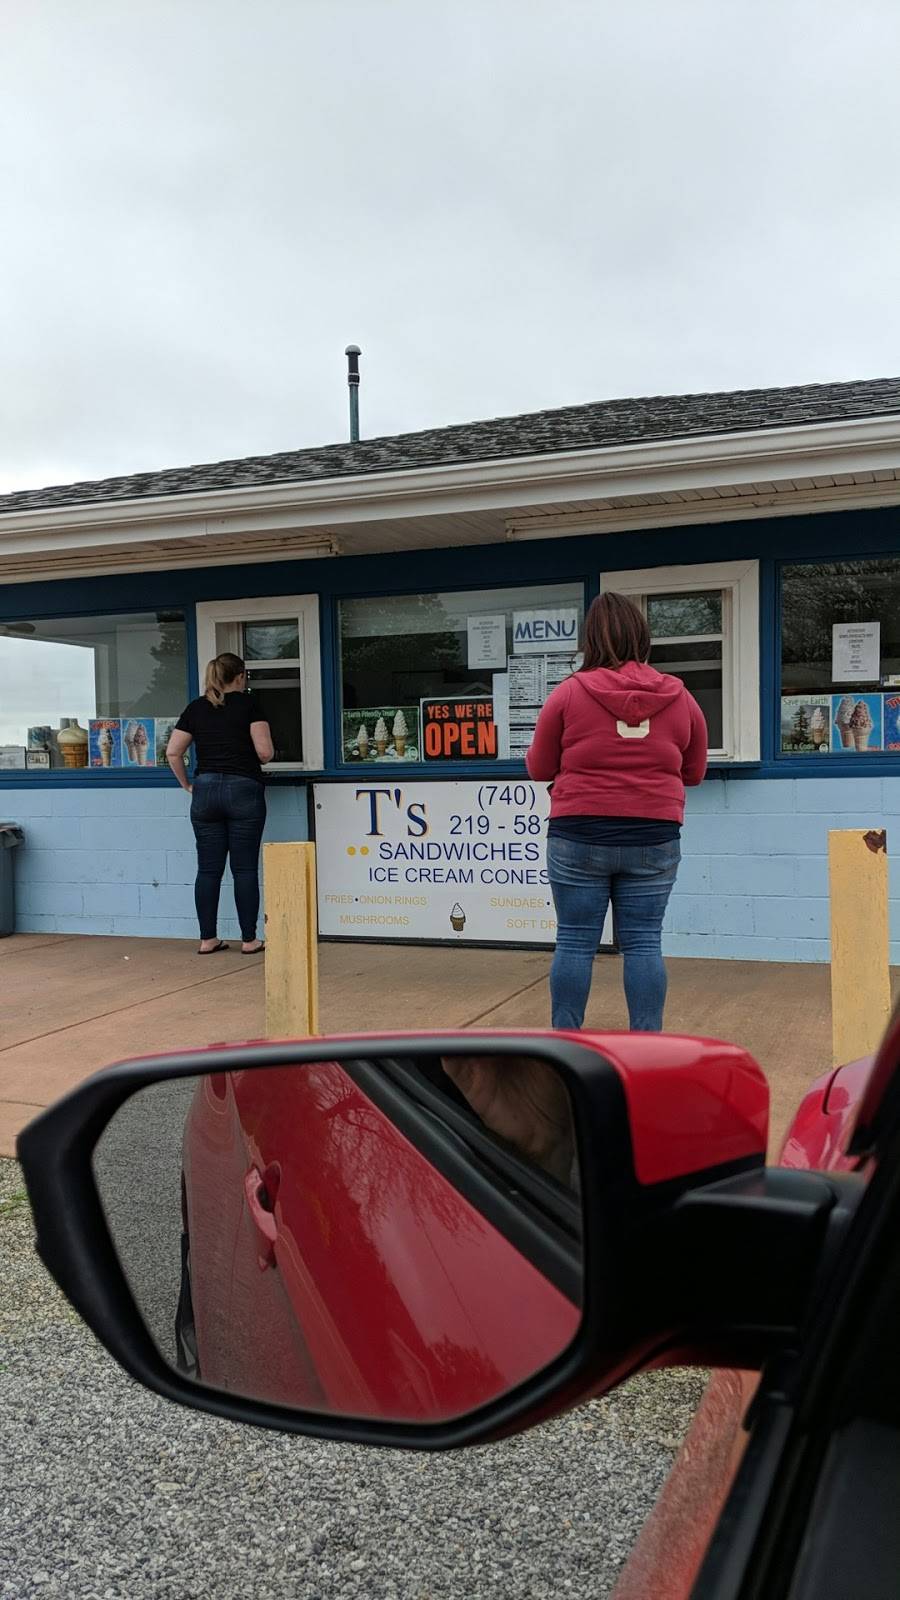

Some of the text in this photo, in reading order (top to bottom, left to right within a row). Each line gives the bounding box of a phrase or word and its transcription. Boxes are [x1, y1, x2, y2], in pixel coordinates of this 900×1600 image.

[515, 619, 576, 639] MENU
[427, 703, 493, 719] YES WE'RE
[425, 721, 497, 757] OPEN
[477, 785, 536, 811] (740)
[355, 788, 430, 837] T's
[449, 815, 490, 835] 219
[513, 814, 551, 836] 58
[379, 842, 540, 861] SANDWICHES
[369, 867, 550, 885] ICE CREAM CONES
[395, 896, 427, 906] RINGS
[490, 897, 544, 908] SUNDAES
[339, 915, 410, 926] MUSHROOMS
[506, 919, 537, 929] SOFT
